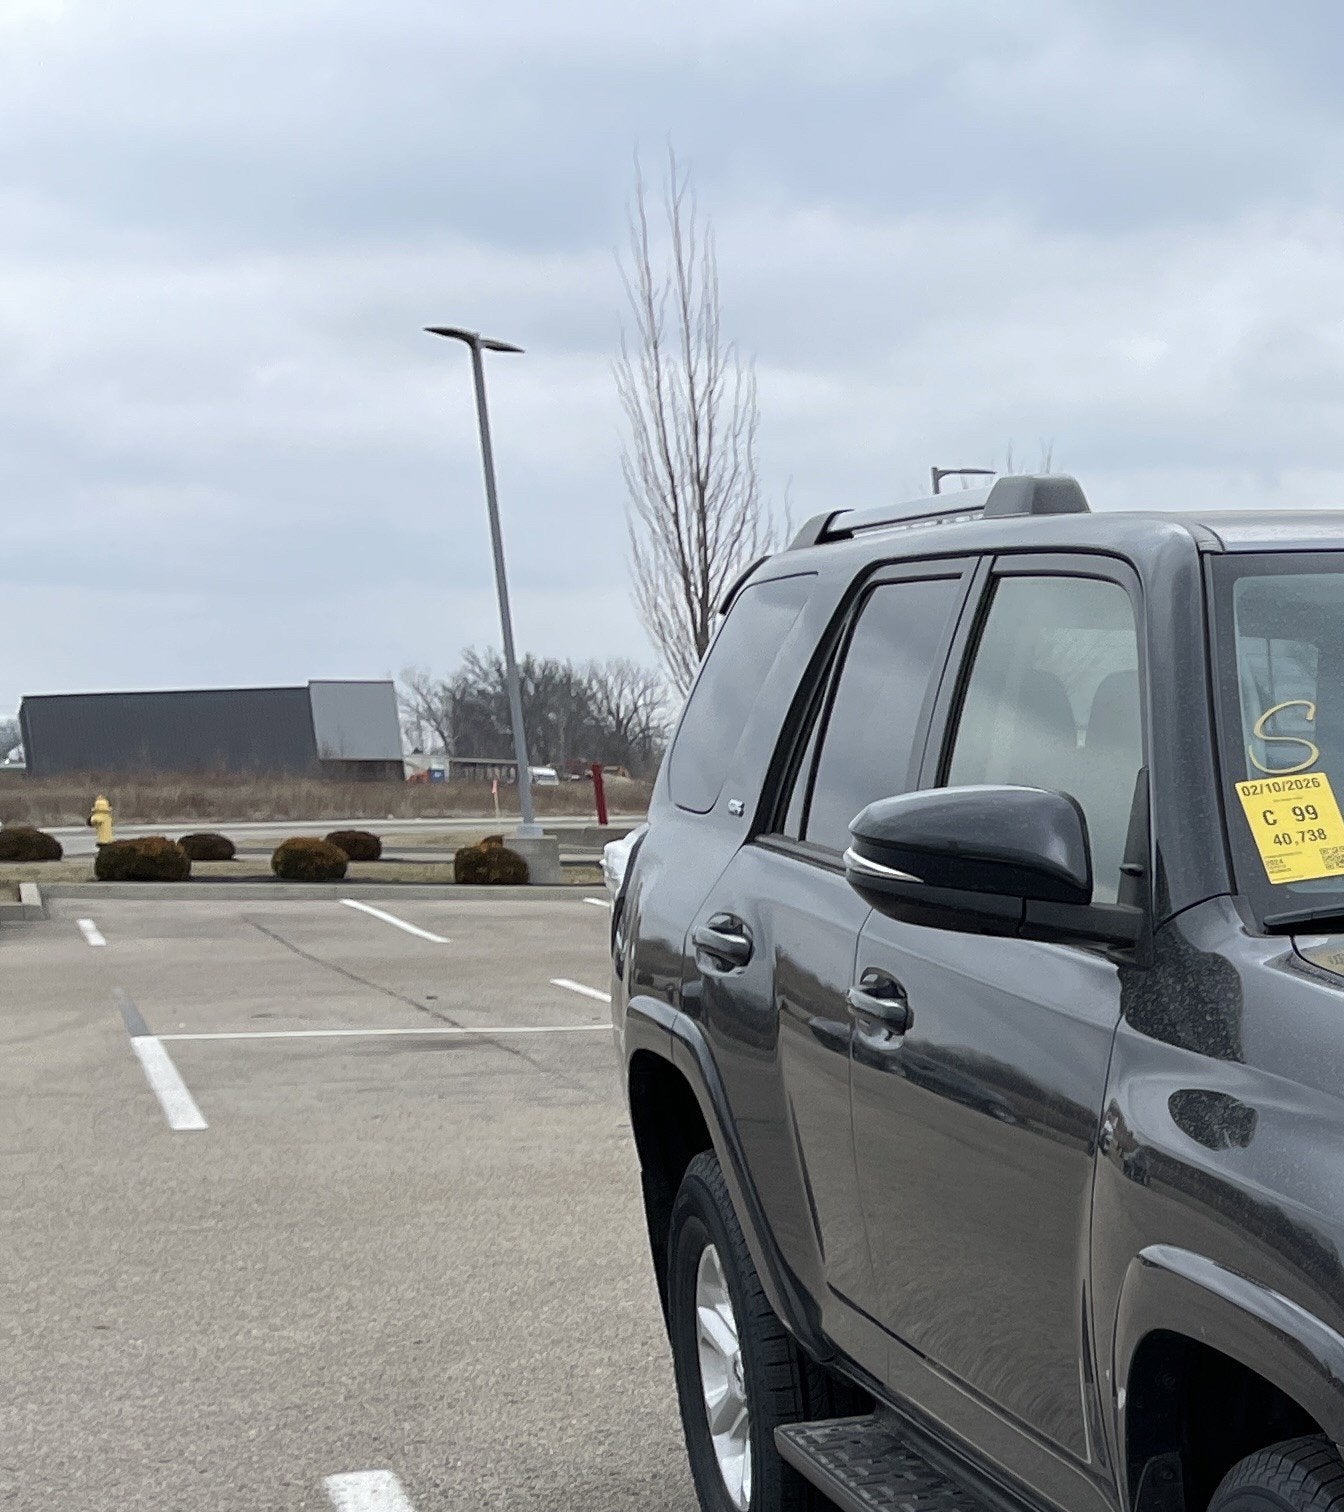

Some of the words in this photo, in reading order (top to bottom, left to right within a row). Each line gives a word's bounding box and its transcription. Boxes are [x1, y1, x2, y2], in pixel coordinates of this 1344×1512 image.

[1248, 700, 1320, 774] S
[1241, 777, 1321, 797] 02/10/2026
[1262, 809, 1277, 826] C
[1292, 804, 1319, 822] 99
[1273, 828, 1328, 846] 40,738
